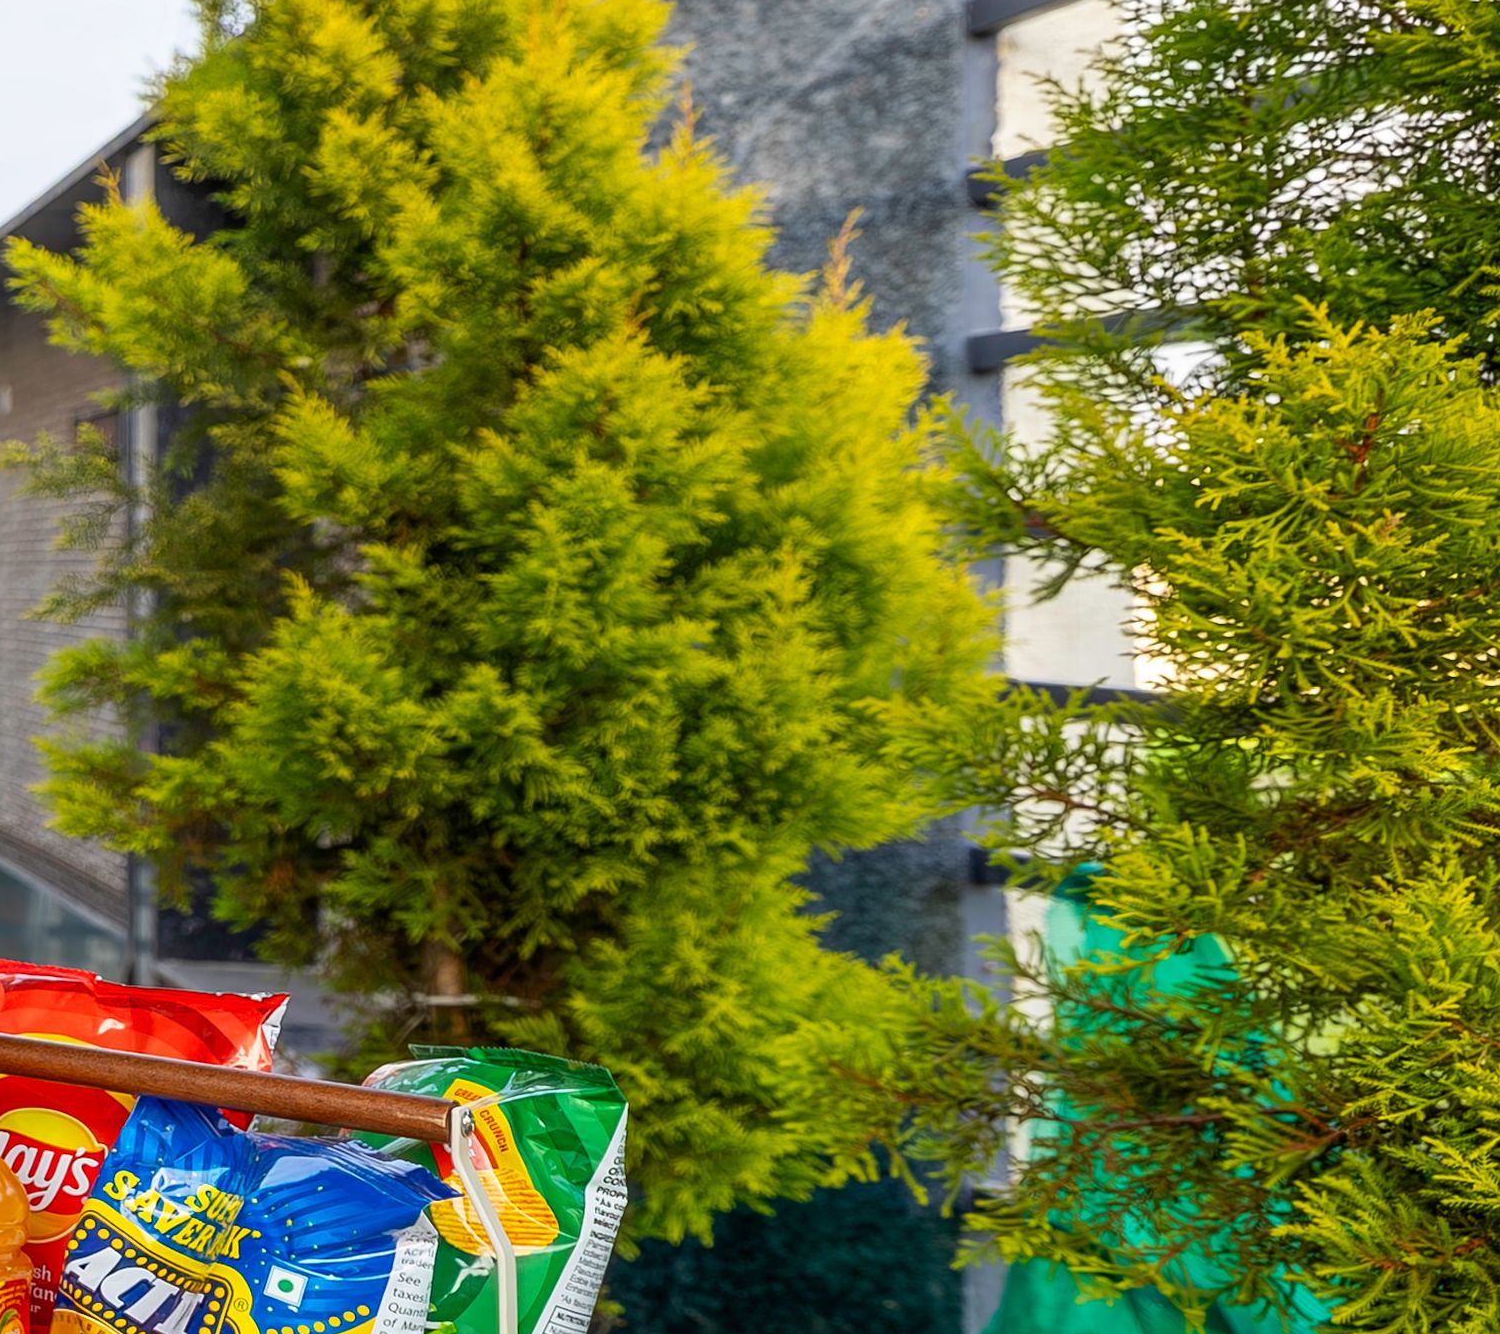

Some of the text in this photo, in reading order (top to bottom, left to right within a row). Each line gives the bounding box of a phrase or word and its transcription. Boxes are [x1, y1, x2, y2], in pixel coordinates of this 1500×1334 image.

[479, 1109, 509, 1153] CRUNCH
[397, 1271, 422, 1287] See
[382, 1317, 396, 1329] of
